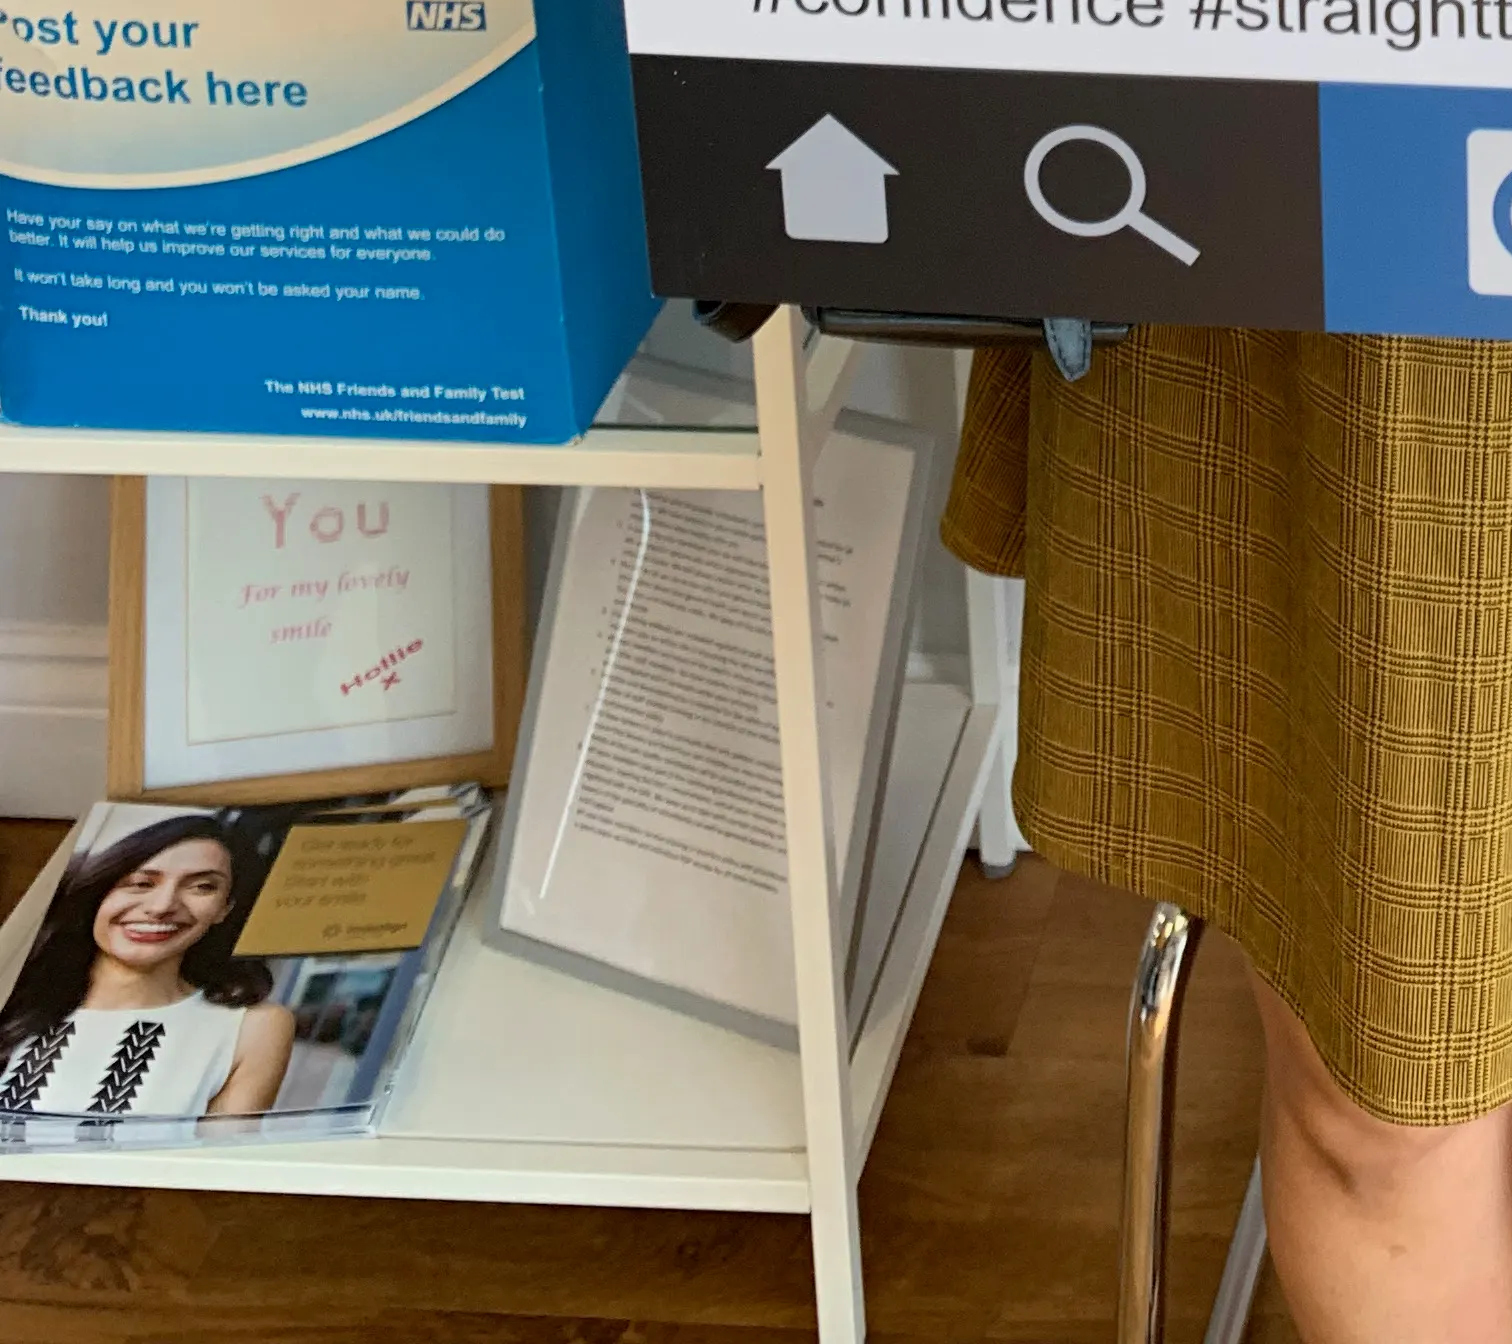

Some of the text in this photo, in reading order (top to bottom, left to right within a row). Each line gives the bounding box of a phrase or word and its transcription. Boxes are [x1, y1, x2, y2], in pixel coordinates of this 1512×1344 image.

[408, 1, 484, 31] NHS
[93, 19, 200, 56] your
[205, 70, 308, 107] here
[7, 208, 506, 242] Have your say on what we're getting right and what we could do
[9, 228, 436, 263] better. It will help us improve our services for everyone.
[14, 267, 426, 301] It won't take long and you won't be asked your name.
[19, 305, 108, 328] Thank you!
[265, 379, 525, 403] The NHS Friends and Family Test
[301, 407, 528, 429] www.nhs.uk/friendsandfamily
[290, 579, 329, 599] my
[337, 565, 410, 595] lovely
[270, 616, 333, 644] smile
[340, 638, 424, 696] Hollie
